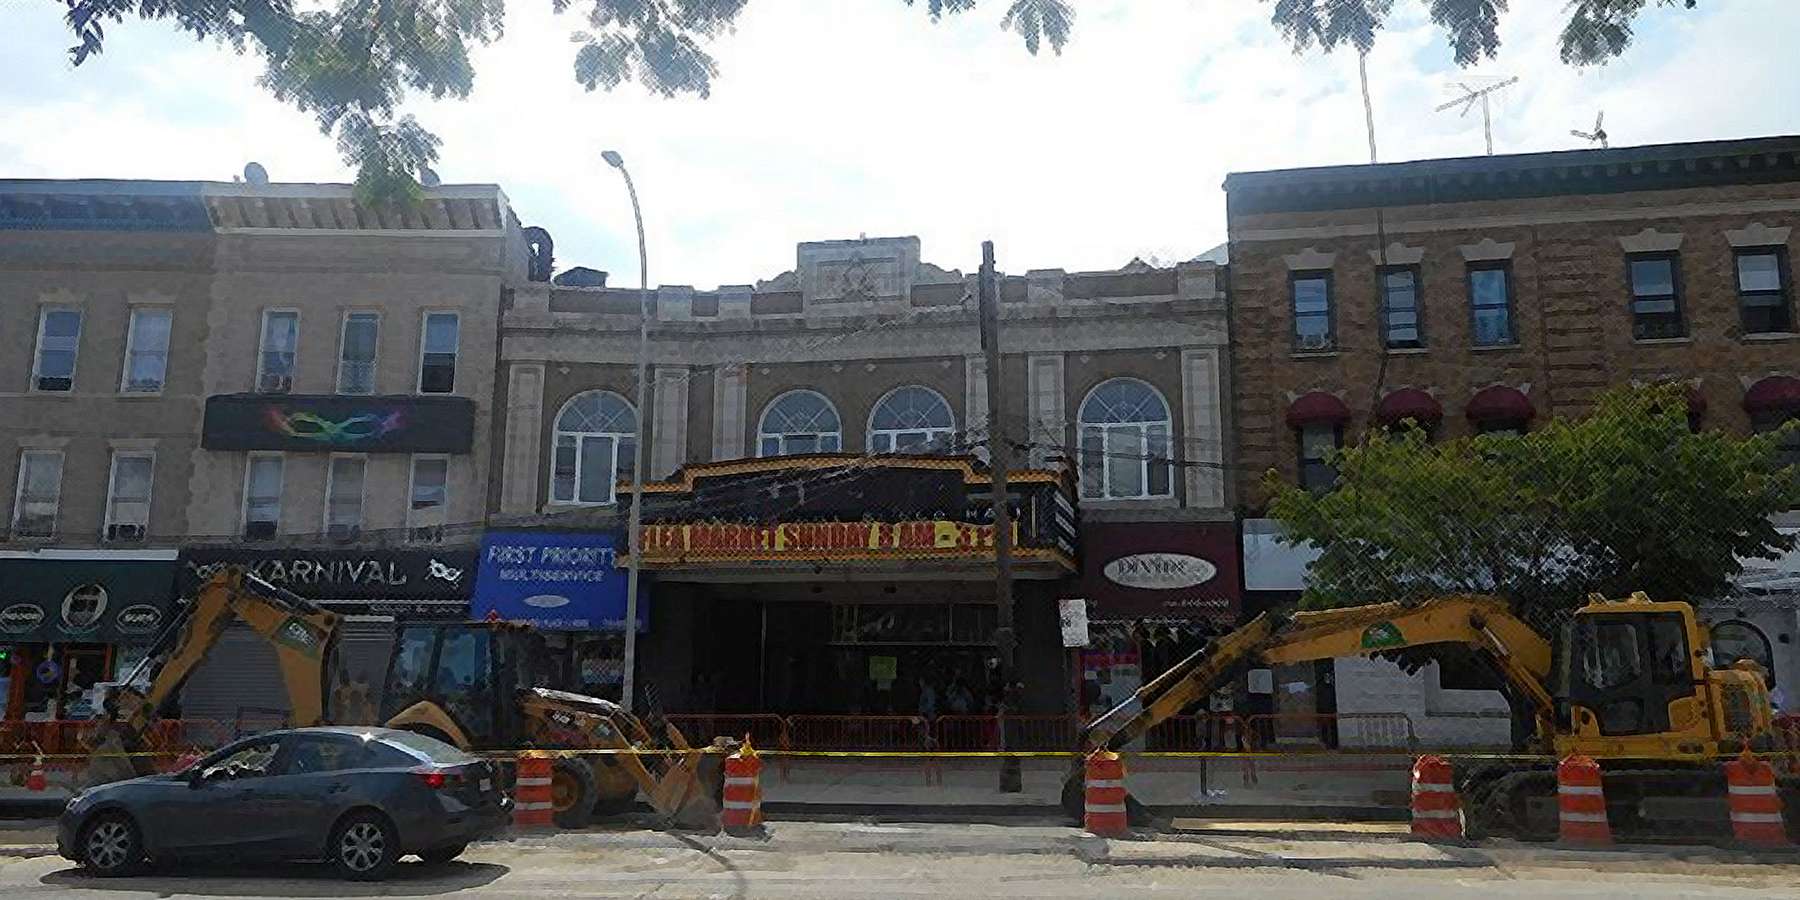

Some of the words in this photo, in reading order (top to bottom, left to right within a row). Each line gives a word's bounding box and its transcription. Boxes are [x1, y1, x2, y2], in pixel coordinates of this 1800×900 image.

[784, 523, 871, 549] SUNDAY
[487, 546, 537, 565] FIRST
[247, 560, 408, 585] KARNIVAL
